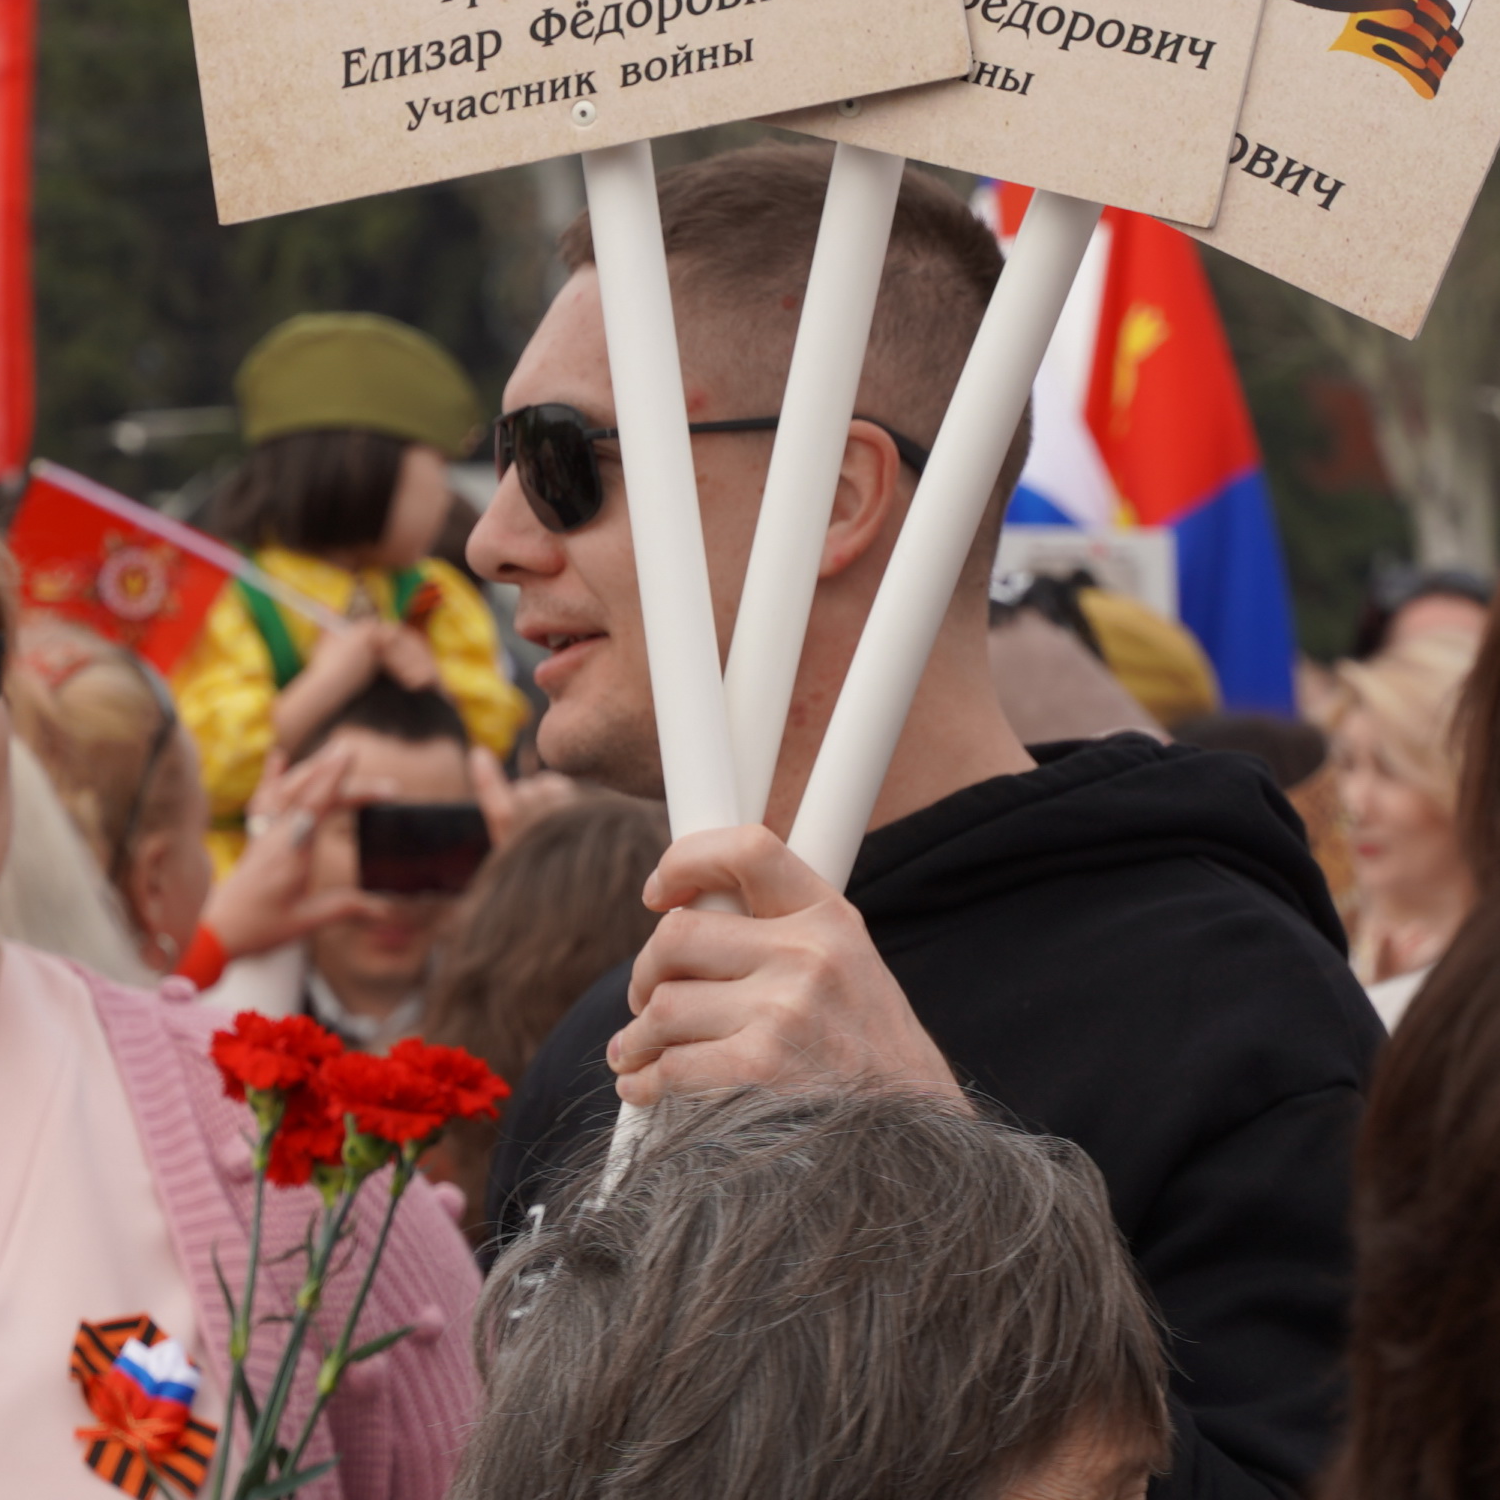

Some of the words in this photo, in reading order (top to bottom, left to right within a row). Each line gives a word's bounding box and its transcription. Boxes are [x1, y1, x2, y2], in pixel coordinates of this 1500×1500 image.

[341, 27, 502, 88] Елизар
[404, 70, 598, 131] Участник
[619, 37, 755, 89] войны
